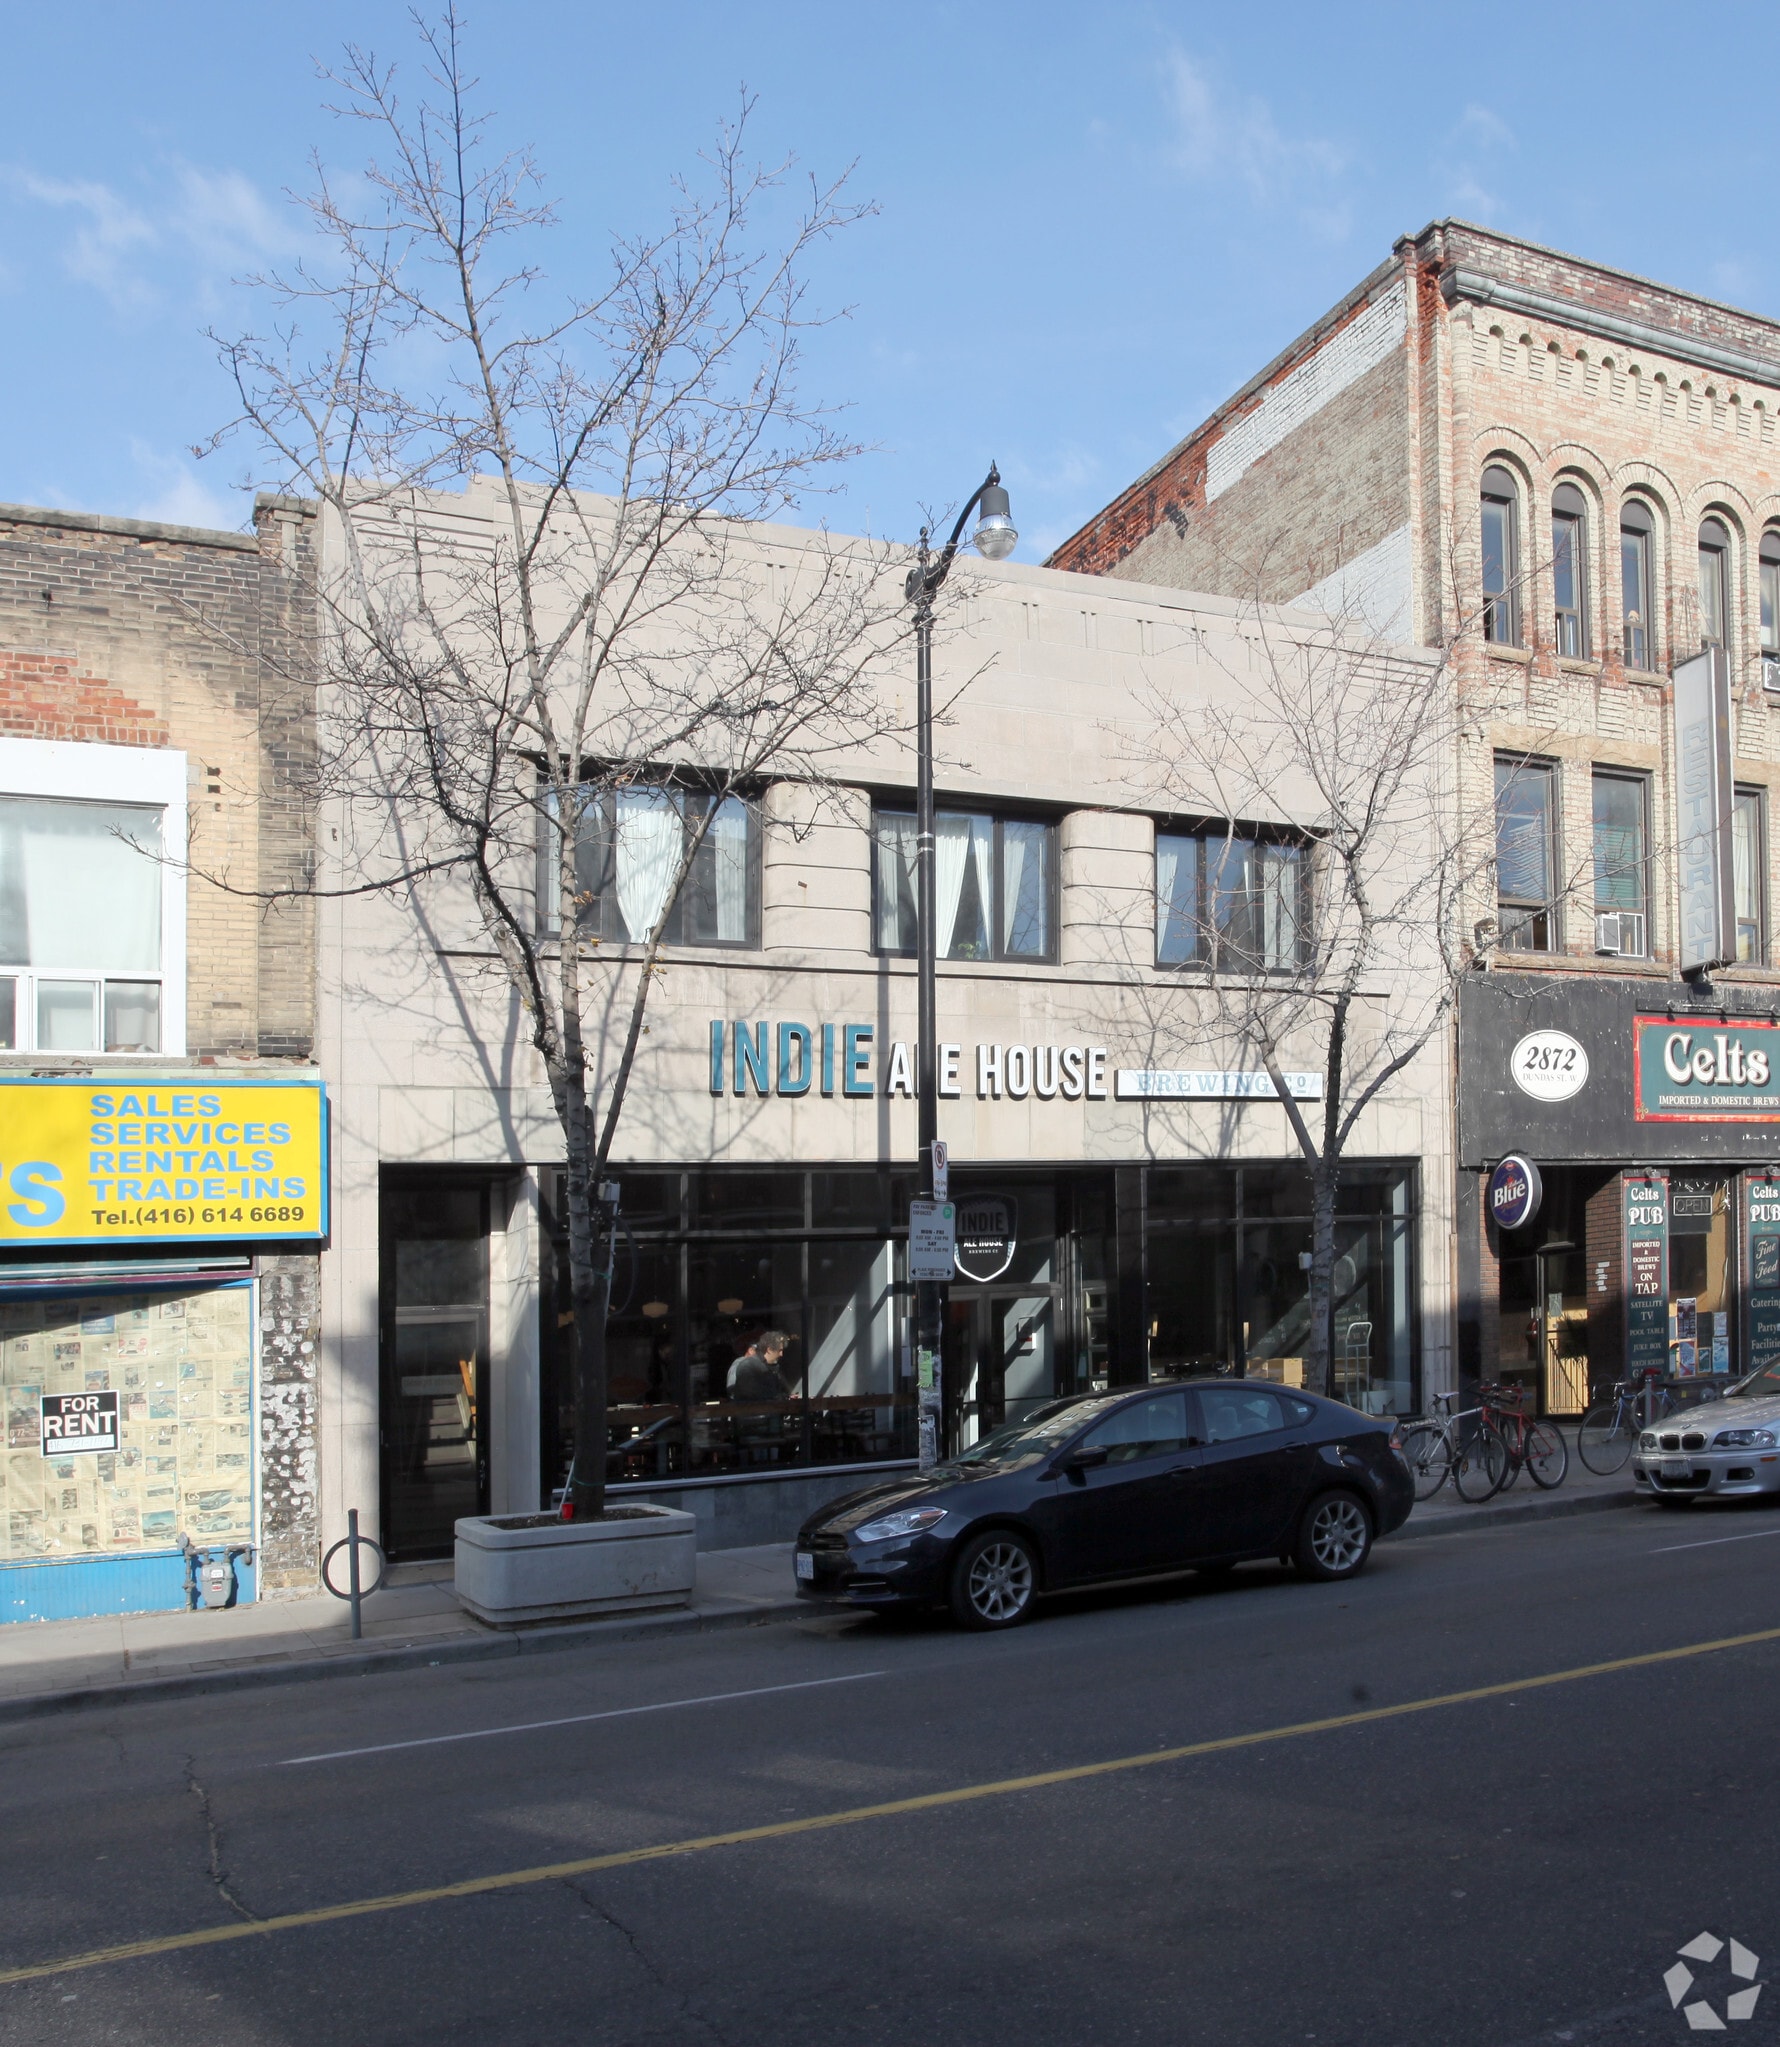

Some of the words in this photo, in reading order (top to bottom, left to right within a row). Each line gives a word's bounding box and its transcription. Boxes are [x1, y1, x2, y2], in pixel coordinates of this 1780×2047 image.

[1683, 723, 1713, 962] RESTAURANT
[709, 1019, 875, 1097] INDIE
[887, 1042, 962, 1099] AE
[976, 1043, 1109, 1101] HOUSE
[1522, 1046, 1577, 1071] 2872
[1663, 1031, 1771, 1087] Celts
[1136, 1073, 1270, 1093] BREWING
[1522, 1073, 1555, 1081] DUNDAS
[1556, 1074, 1567, 1082] ST.
[89, 1094, 222, 1118] SALES
[1658, 1095, 1701, 1105] IMPORTED
[1703, 1097, 1709, 1105] &
[1711, 1096, 1751, 1106] DOMESTIC
[1752, 1096, 1779, 1106] BREWS
[89, 1122, 292, 1146] SERVICES
[88, 1149, 275, 1174] RENTALS
[0, 1160, 66, 1228] S
[88, 1176, 307, 1202] TRADE-INS
[1492, 1182, 1526, 1209] Blue
[1630, 1187, 1660, 1201] Celts
[1752, 1185, 1779, 1199] Celts
[201, 1207, 243, 1223] 614
[250, 1206, 305, 1222] 6689
[1675, 1199, 1709, 1212] OPEN
[1750, 1204, 1780, 1223] PUB
[961, 1211, 1004, 1233] INDIE
[1628, 1206, 1664, 1226] PUB
[963, 1237, 977, 1248] ALE
[978, 1236, 1004, 1247] HOUSE
[1755, 1240, 1777, 1260] Fine
[1640, 1272, 1653, 1281] ON
[1755, 1260, 1779, 1280] Food
[1635, 1282, 1659, 1295] TAP
[1630, 1300, 1664, 1309] SATELLITE
[1641, 1311, 1654, 1321] TV
[1629, 1328, 1645, 1336] POOL
[1757, 1321, 1777, 1335] Party
[1633, 1343, 1648, 1352] JUKE
[1649, 1342, 1662, 1350] BOX
[60, 1395, 99, 1413] FOR
[43, 1410, 116, 1438] RENT
